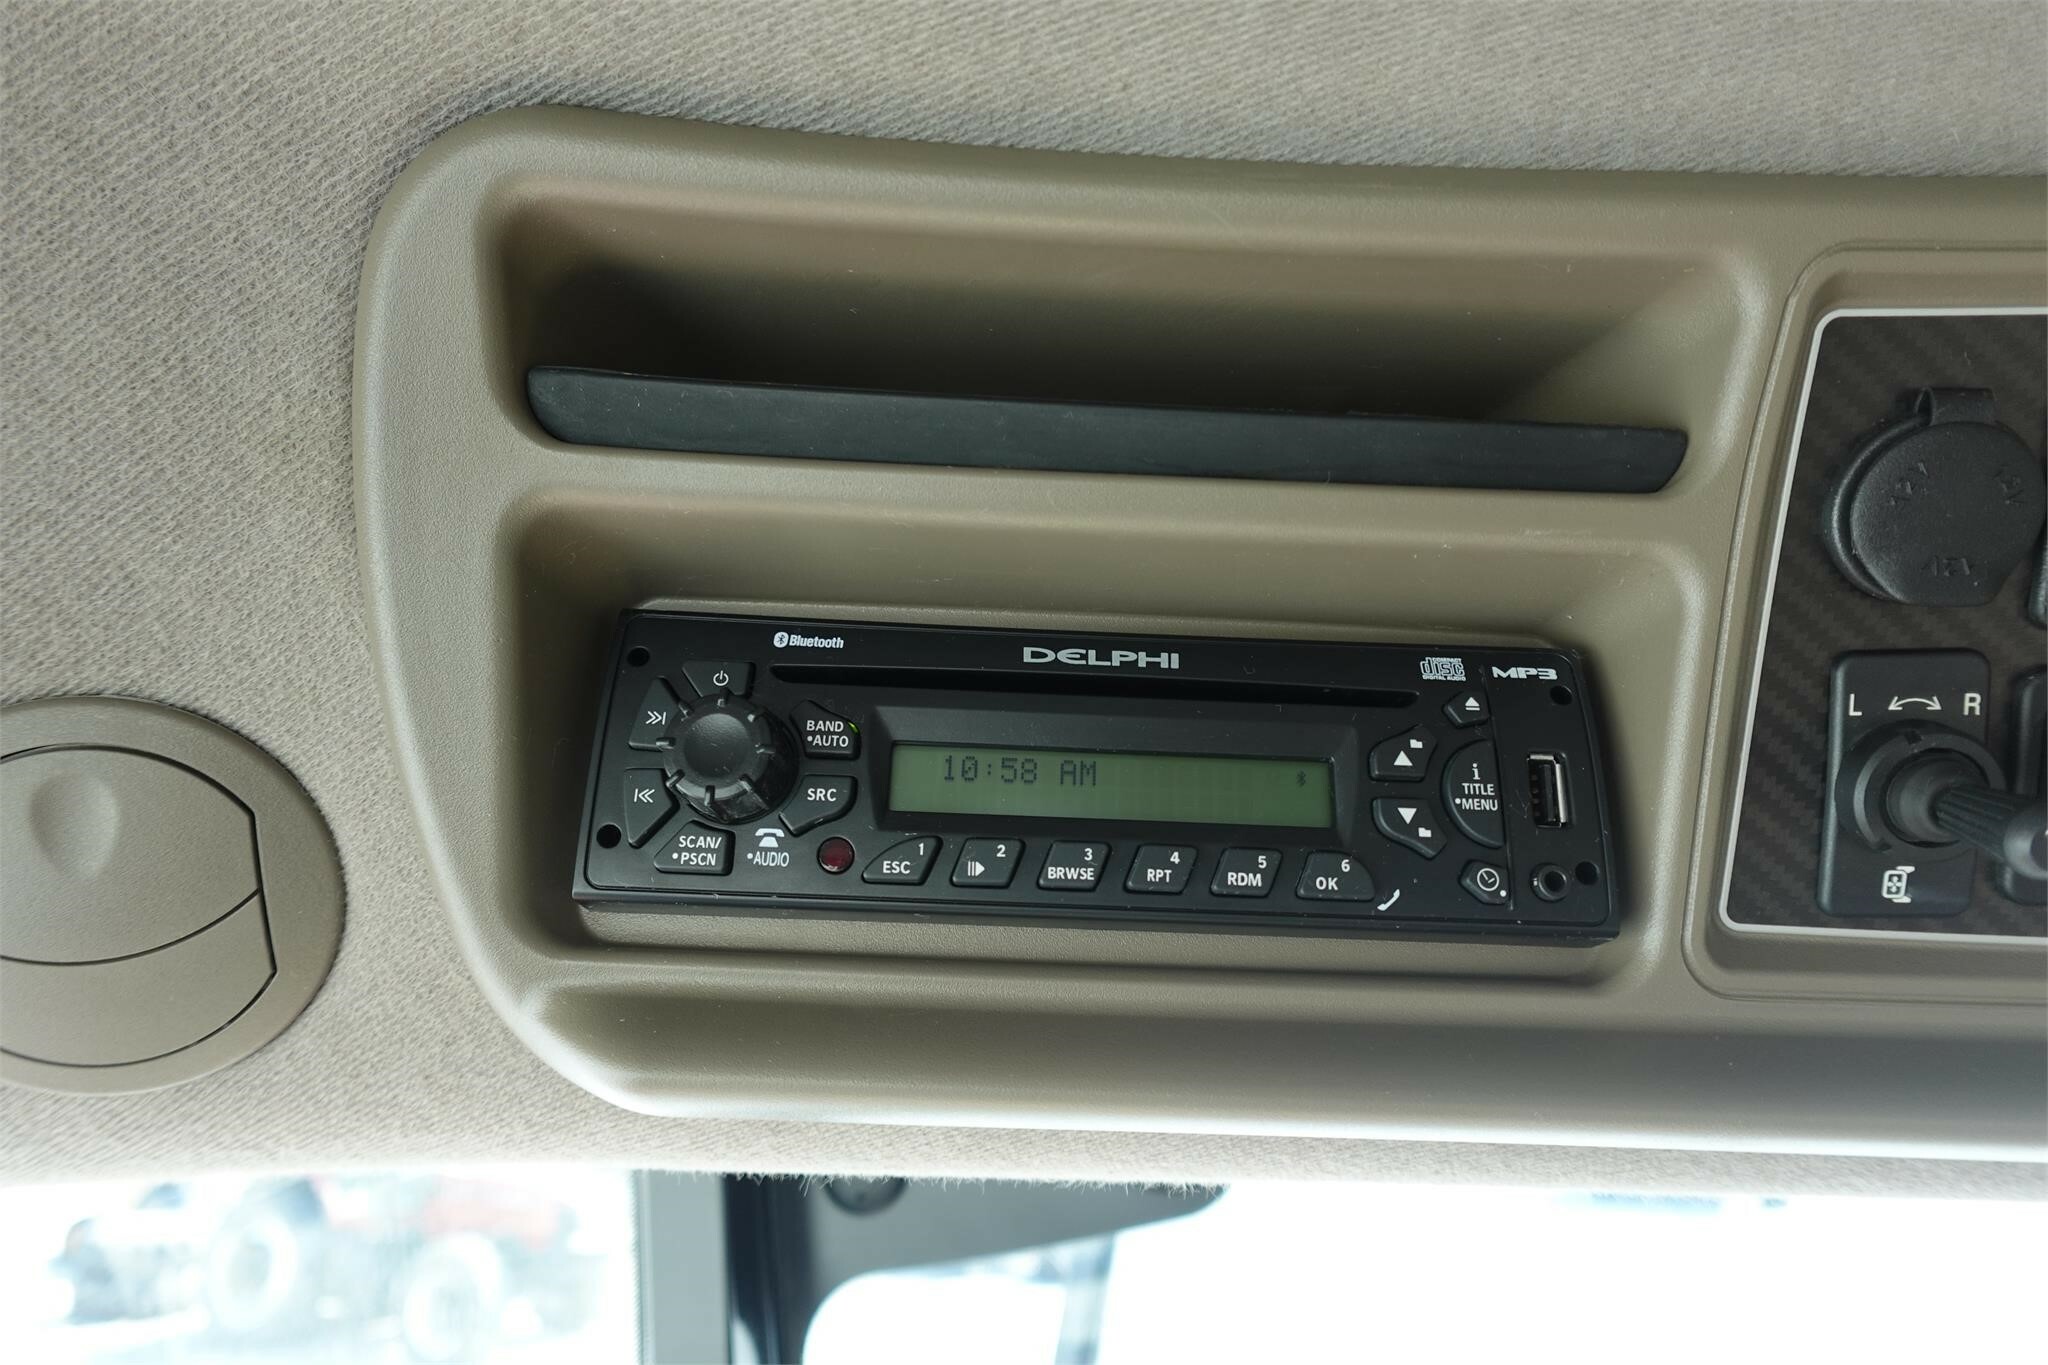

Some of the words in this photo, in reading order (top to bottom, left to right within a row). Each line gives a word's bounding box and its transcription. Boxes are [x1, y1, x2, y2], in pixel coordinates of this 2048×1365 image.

[789, 633, 844, 648] Bluetooth
[1023, 646, 1180, 669] DELPHI
[1491, 666, 1558, 680] MP3
[1849, 693, 1863, 716] L
[1963, 693, 1982, 715] R
[806, 719, 844, 733] BAND
[943, 755, 1038, 783] 10:58
[1060, 760, 1097, 786] AM
[807, 788, 837, 802] SRC
[1461, 782, 1495, 796] TITLE
[678, 835, 722, 848] SCAN/
[918, 843, 925, 856] 1
[996, 845, 1006, 858] 2
[1083, 848, 1093, 861] 3
[1169, 851, 1180, 865] 4
[1257, 855, 1267, 869] 5
[882, 860, 911, 874] ESC
[1341, 859, 1351, 873] 6
[1047, 866, 1095, 881] BRWSE
[1146, 868, 1172, 883] RPT
[1227, 871, 1262, 887] RDM
[1315, 876, 1338, 891] OK
